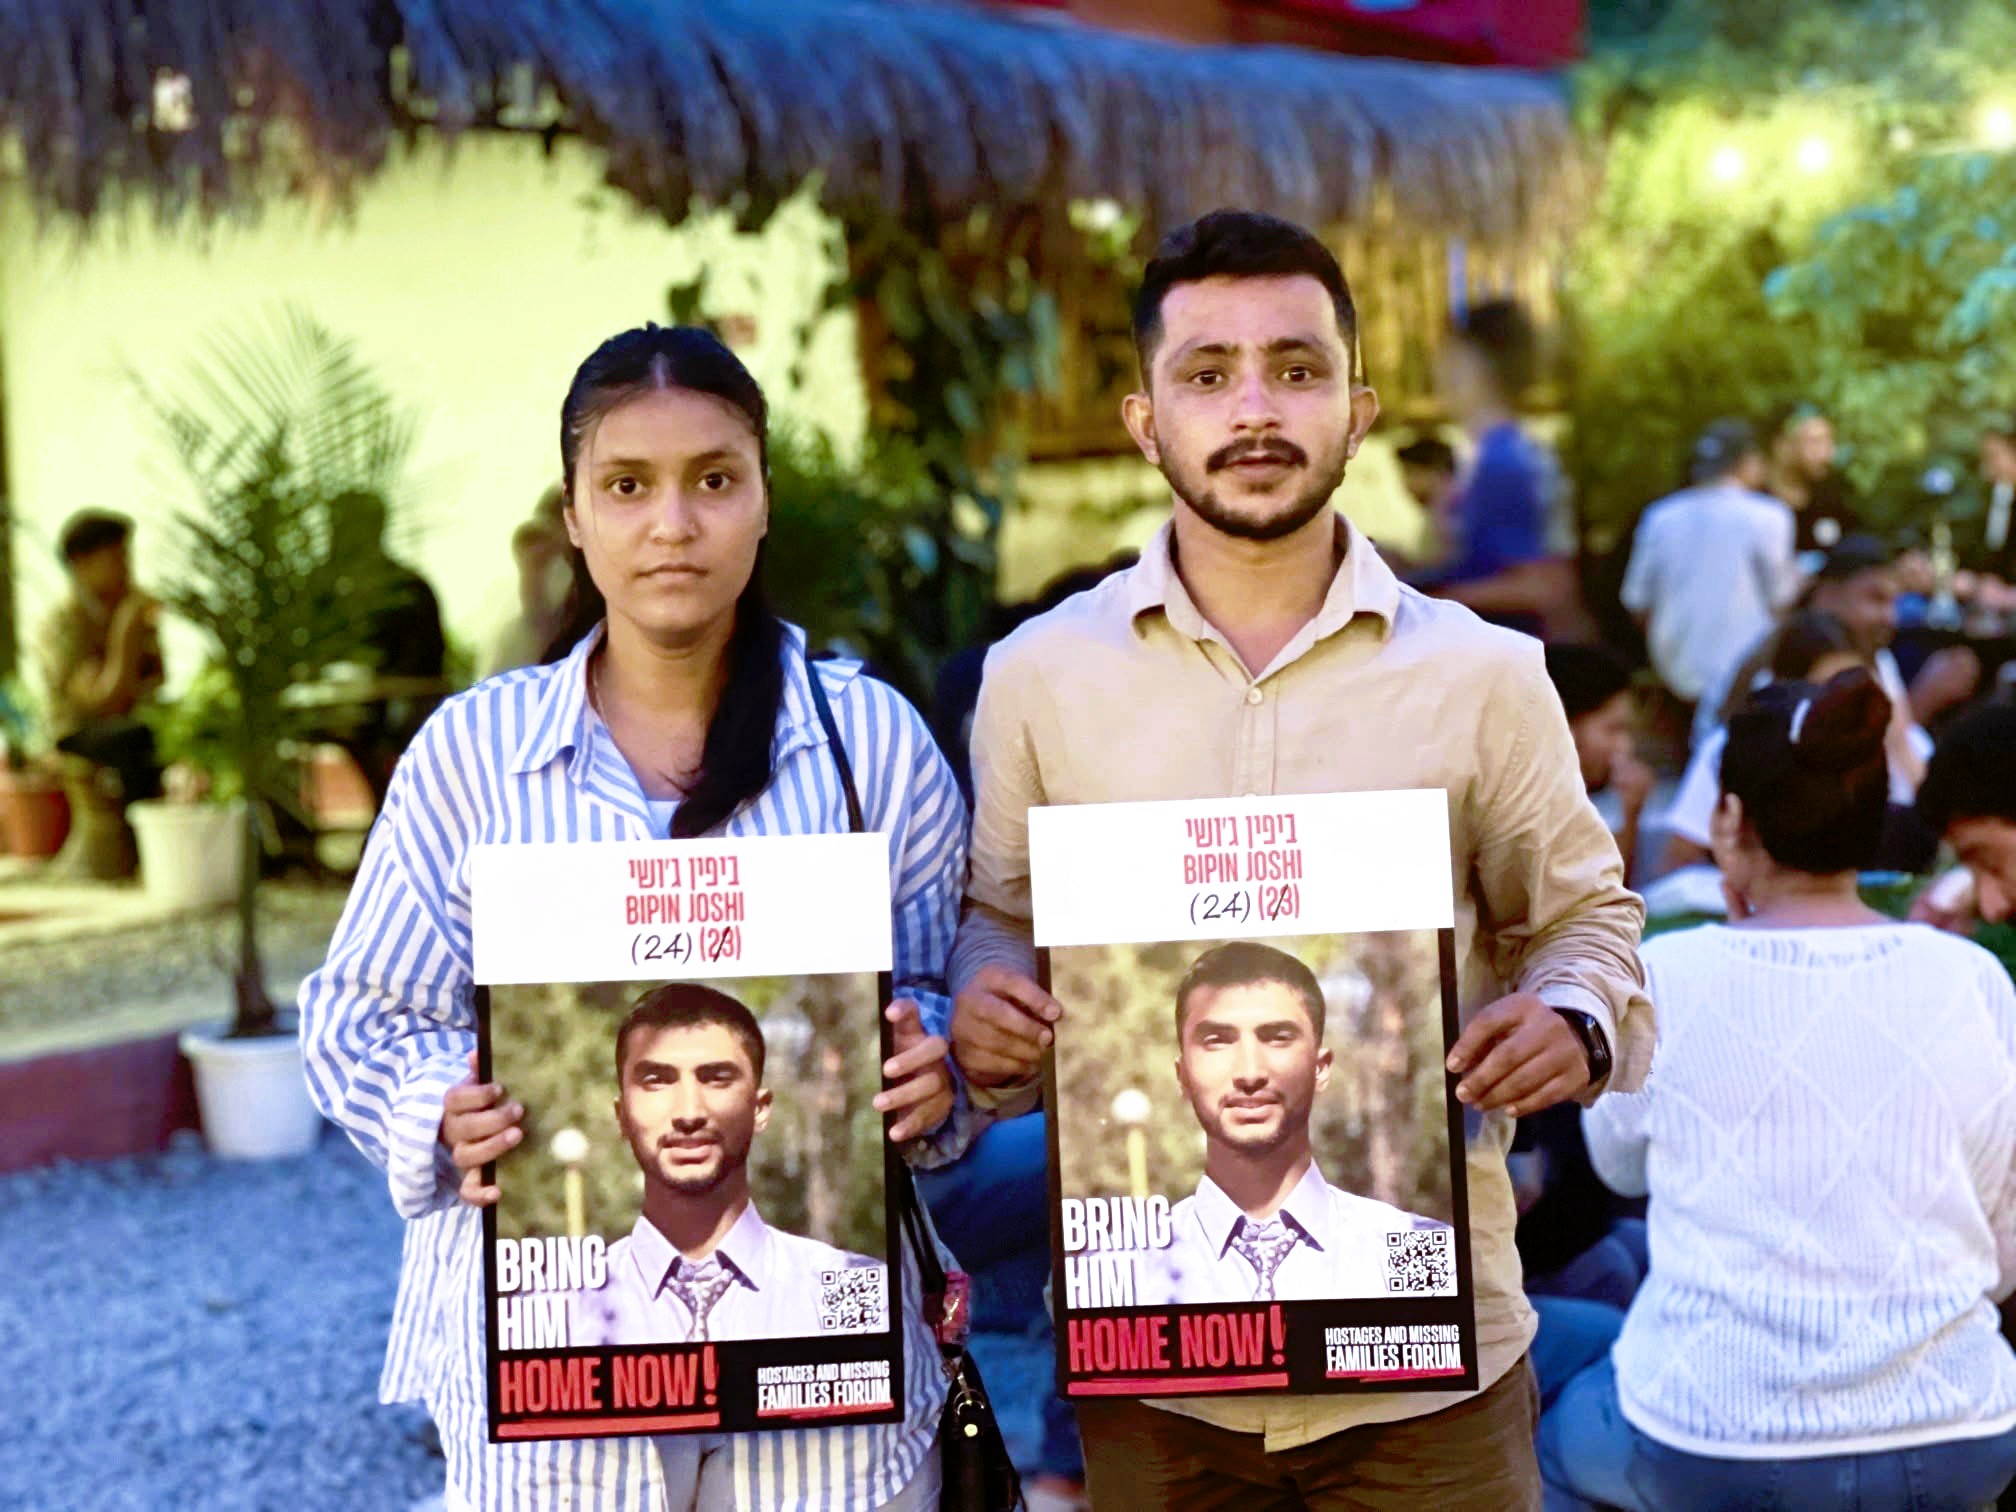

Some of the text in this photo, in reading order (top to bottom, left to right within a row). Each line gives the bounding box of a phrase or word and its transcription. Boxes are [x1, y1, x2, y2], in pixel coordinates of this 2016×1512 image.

[1244, 813, 1297, 849] ביפין
[688, 855, 739, 890] ביפין
[1183, 849, 1303, 884] BIPIN JOSHI
[626, 892, 745, 926] BIPIN JOSHI
[1190, 891, 1251, 925] (24)
[631, 933, 692, 964] (24)
[1062, 1195, 1171, 1252] BRING
[495, 1235, 607, 1292] BRING
[1065, 1256, 1136, 1309] HIM
[497, 1296, 570, 1350] HIM
[1067, 1305, 1285, 1373] HOME NOW!
[1325, 1325, 1459, 1345] HOSTAGES AND MISSING
[757, 1360, 890, 1384] HOSTAGES AND MISSING
[1327, 1344, 1461, 1372] FAMILIES FORUM
[499, 1345, 719, 1414] HOME NOW!
[758, 1379, 891, 1410] FAMILIES FORUM
